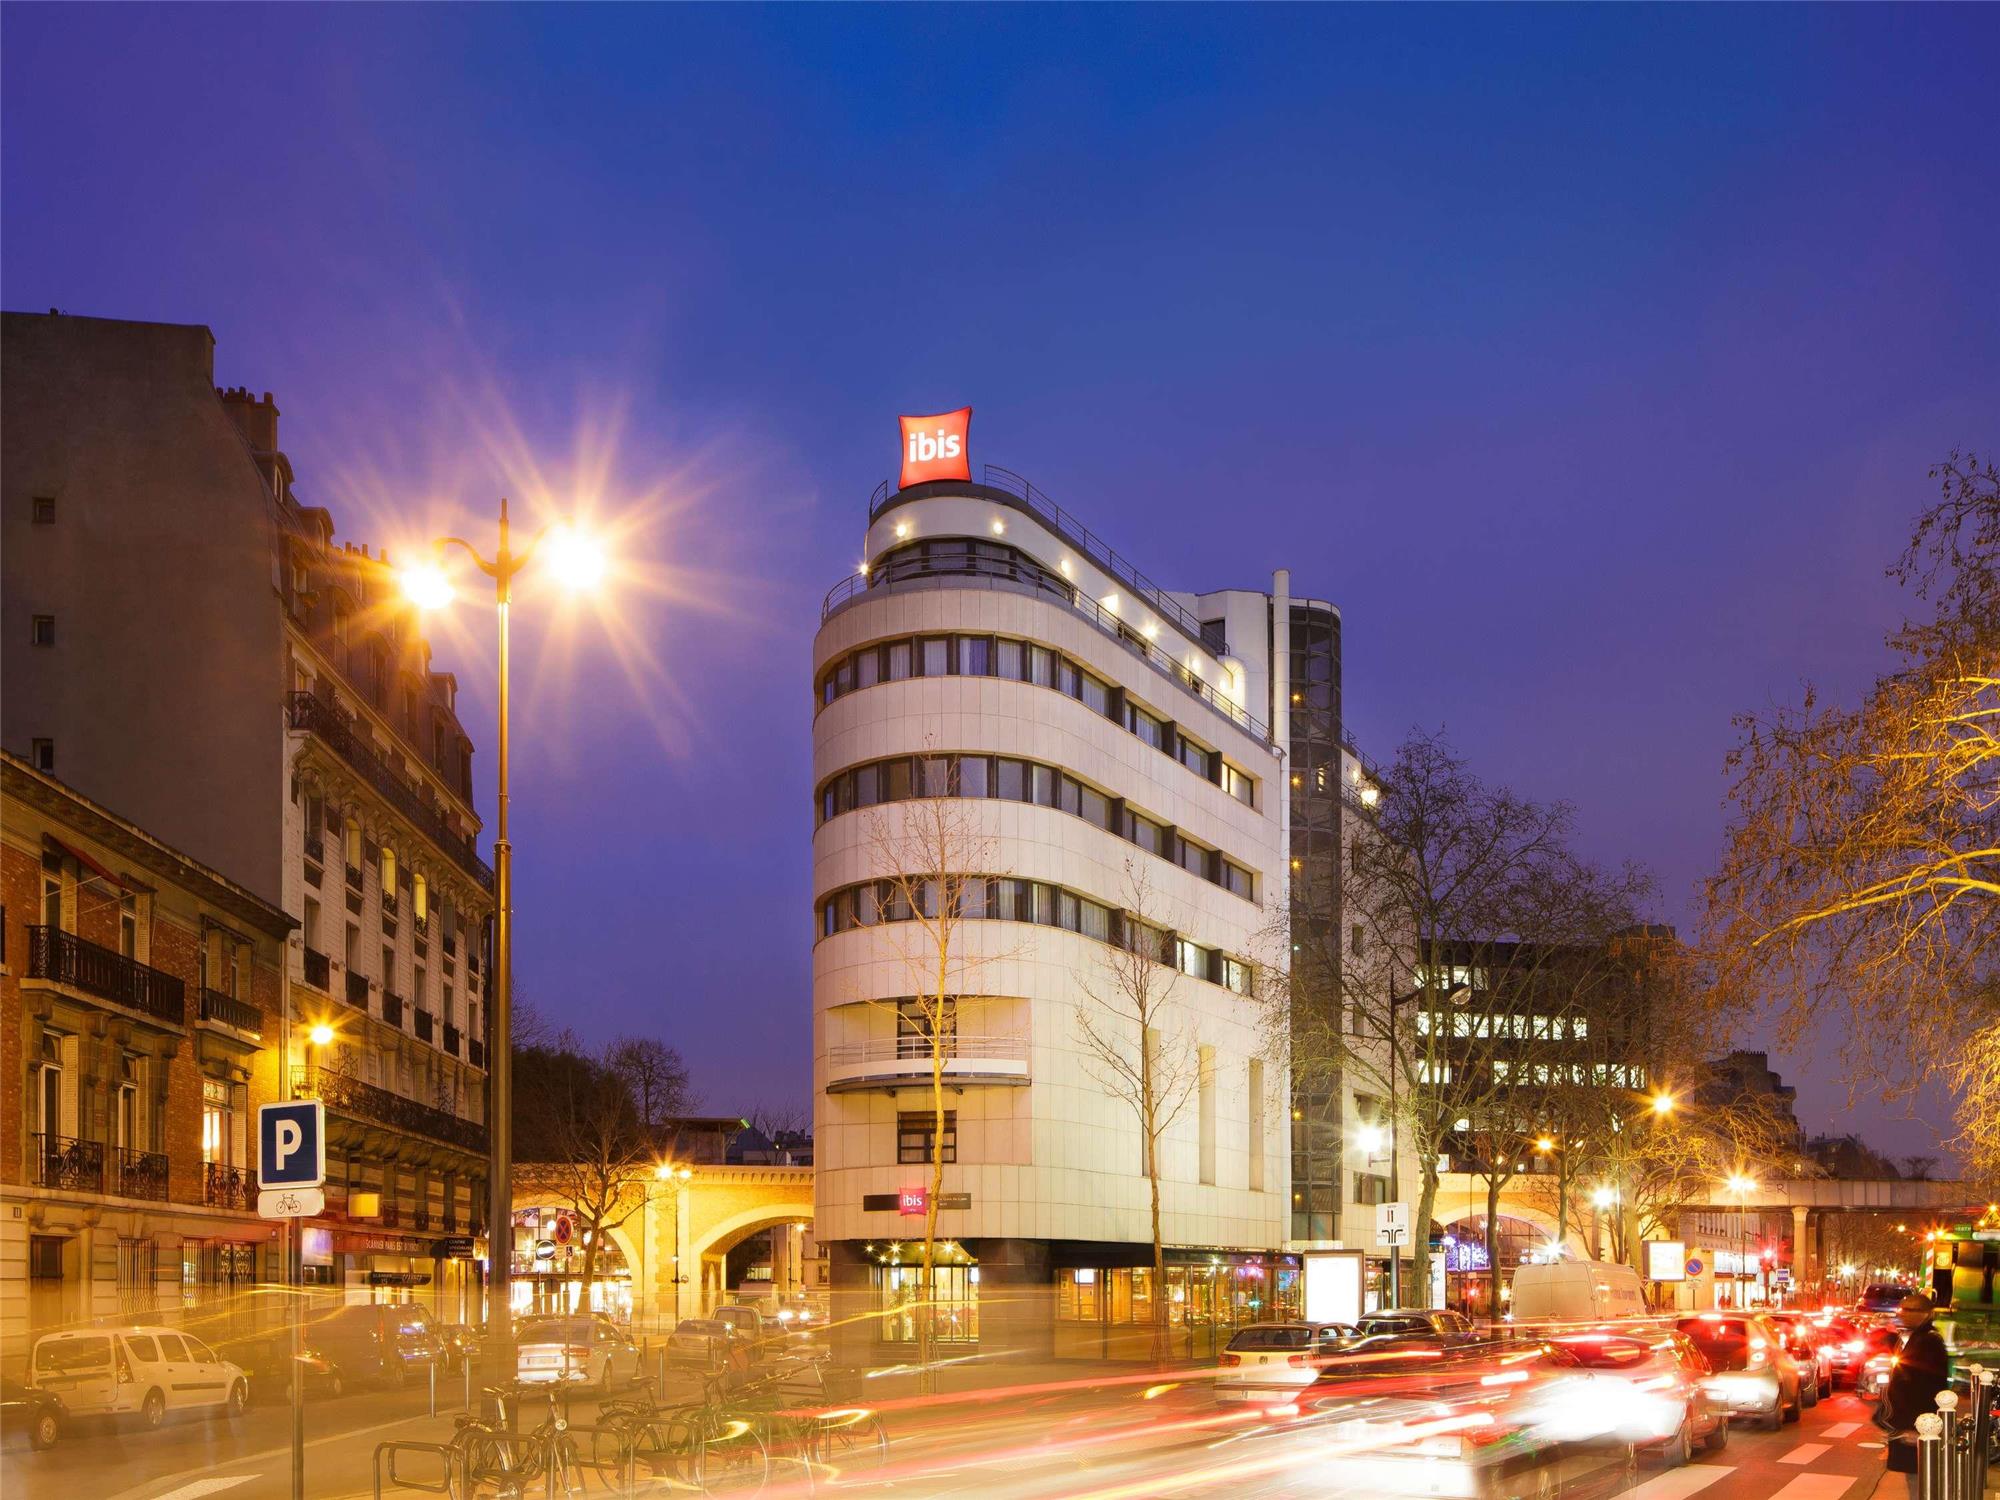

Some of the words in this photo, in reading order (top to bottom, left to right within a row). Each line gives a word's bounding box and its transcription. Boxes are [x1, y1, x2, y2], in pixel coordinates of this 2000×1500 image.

[909, 429, 960, 463] ibis
[276, 1119, 302, 1170] P
[903, 1194, 922, 1206] ibis
[366, 1239, 384, 1250] SCANNER
